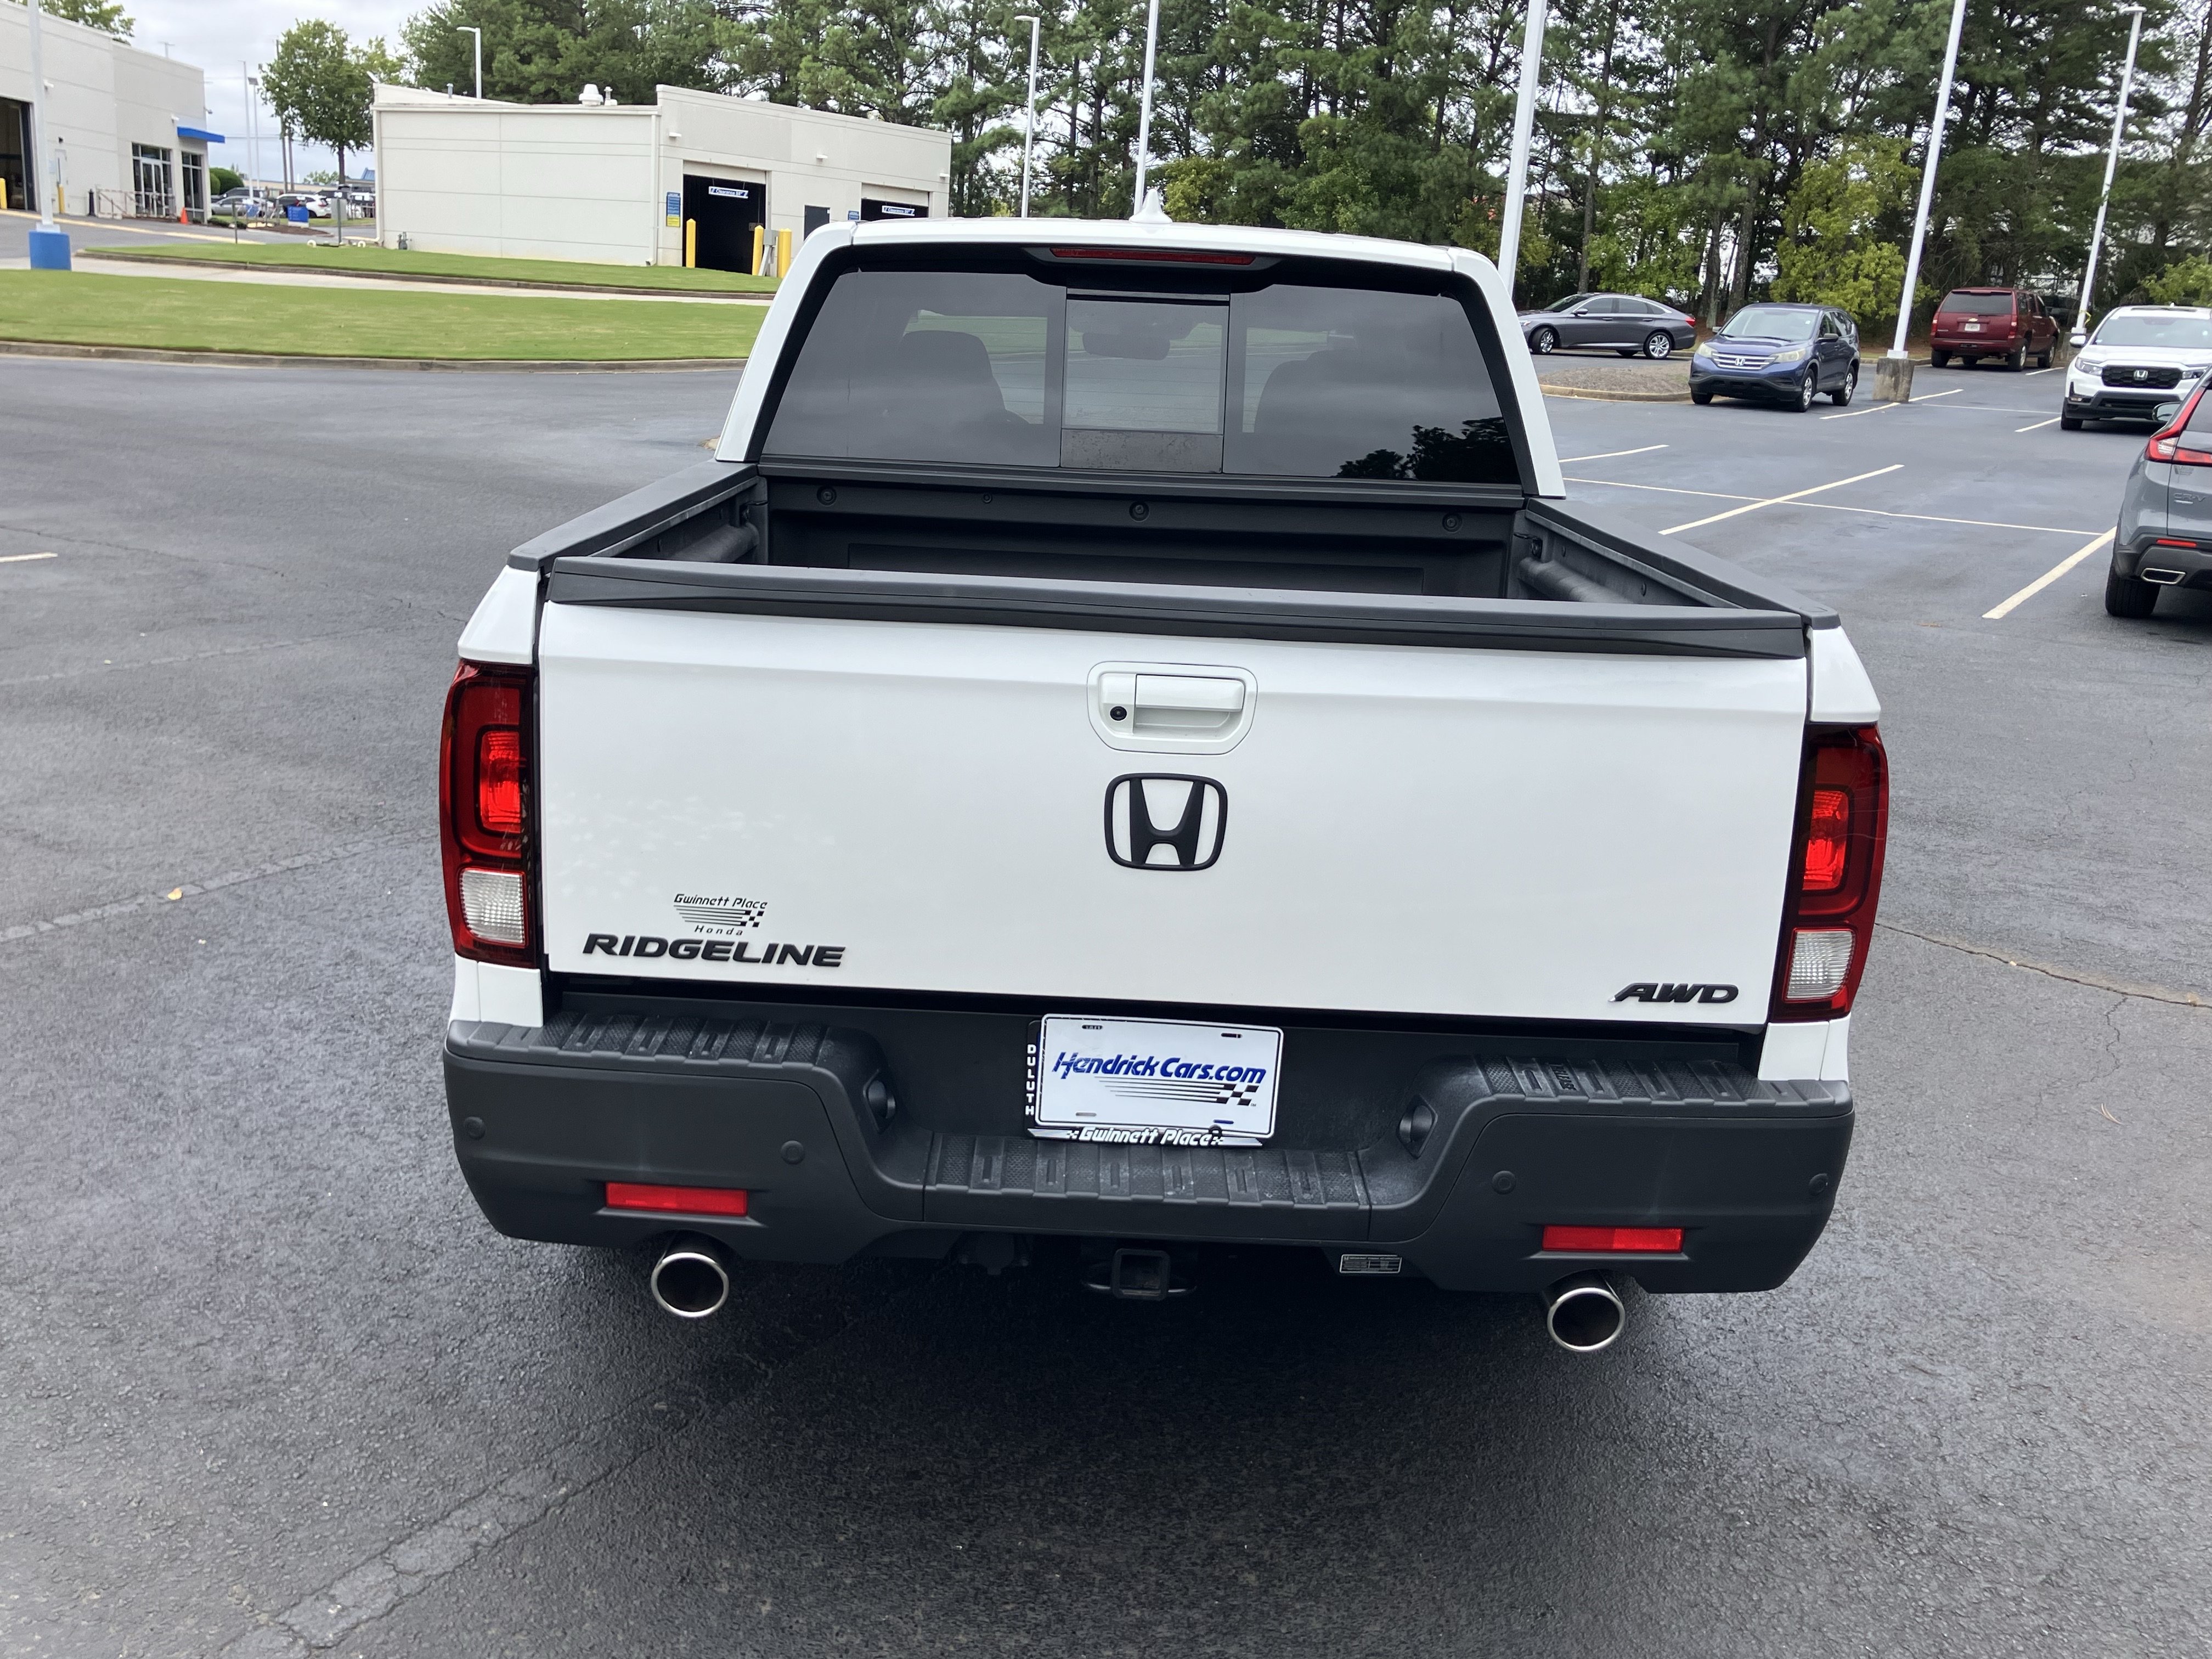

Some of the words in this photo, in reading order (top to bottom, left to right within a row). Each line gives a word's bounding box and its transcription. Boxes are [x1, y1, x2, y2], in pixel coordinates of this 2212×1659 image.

[674, 894, 729, 906] Gwinnett
[732, 897, 768, 909] Place
[694, 925, 743, 935] Honda
[583, 933, 846, 967] RIDGELINE
[1607, 983, 1739, 1003] AWD
[1025, 1044, 1037, 1115] DULUTH
[1079, 1126, 1159, 1144] Gwinnett
[1160, 1128, 1212, 1146] Place
